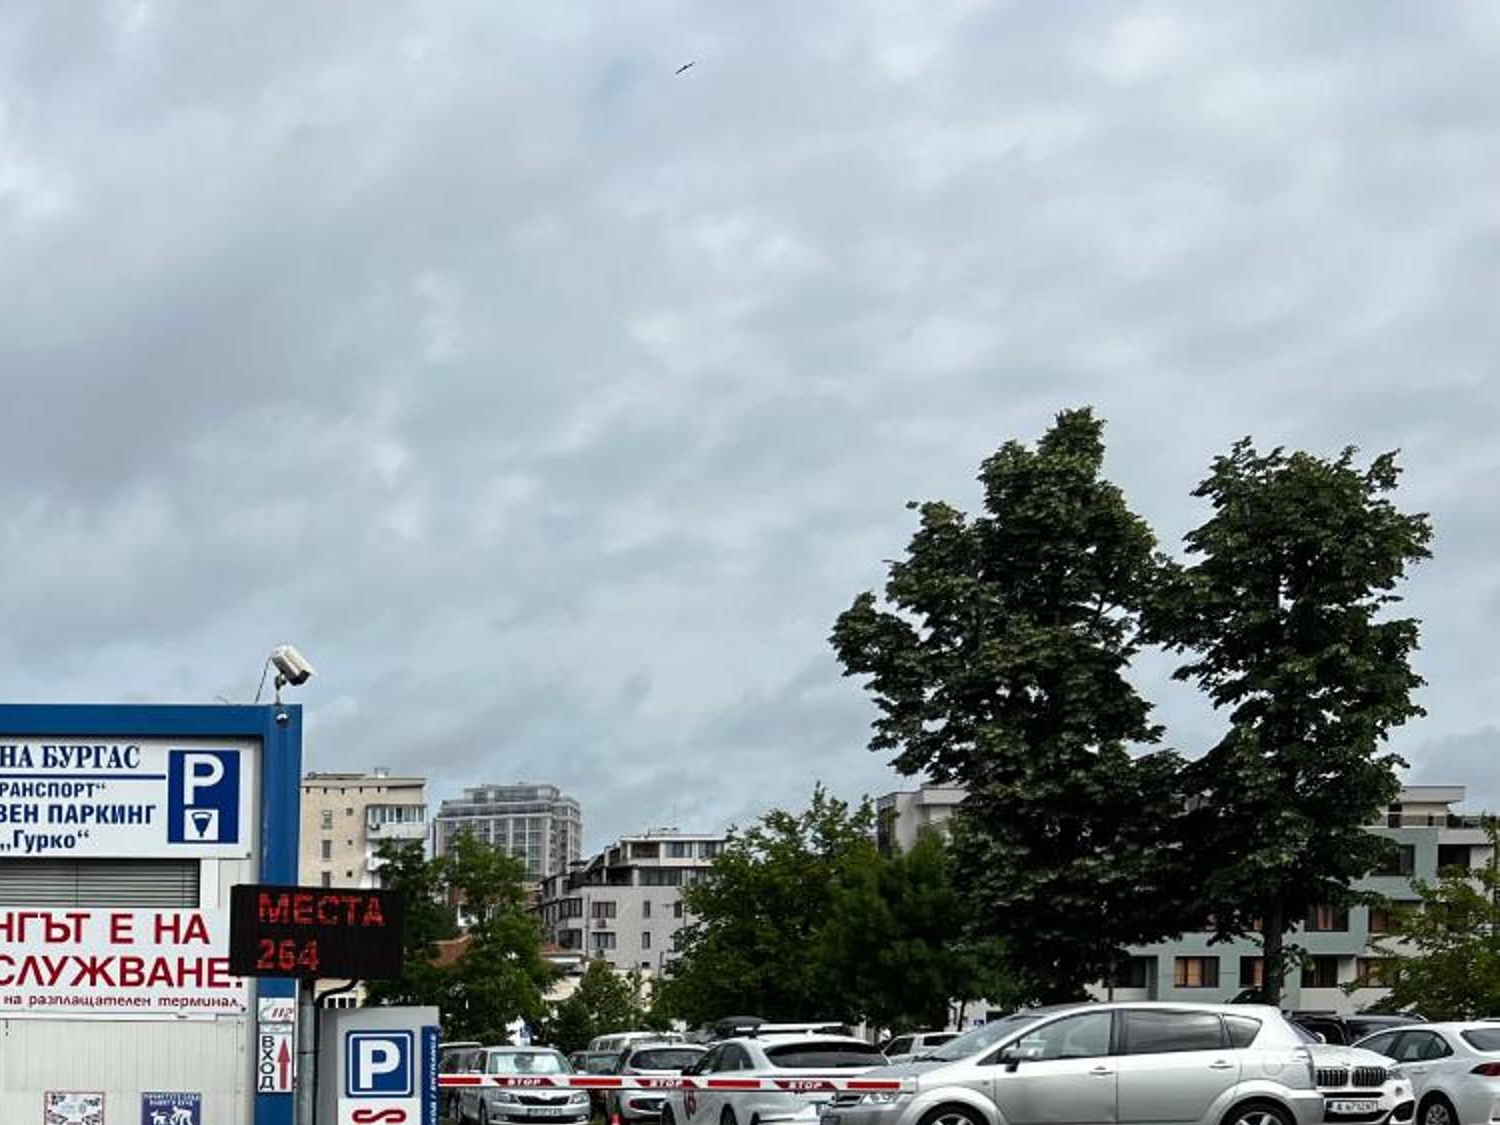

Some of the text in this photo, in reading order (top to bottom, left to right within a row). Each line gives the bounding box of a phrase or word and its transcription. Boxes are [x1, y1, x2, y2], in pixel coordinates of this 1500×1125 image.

[40, 744, 141, 770] БУРГАС
[184, 753, 225, 805] P
[47, 804, 157, 825] ПАРКИНГ
[0, 830, 89, 853] „Гурко“
[258, 892, 386, 926] МЕСТА
[110, 913, 134, 945] Е
[154, 913, 211, 945] НА
[257, 938, 319, 971] 264
[4, 994, 23, 1005] на
[29, 994, 152, 1009] разплащателен
[259, 1035, 275, 1090] ВХОД
[359, 1039, 401, 1089] P
[507, 1077, 542, 1086] STOP
[650, 1079, 684, 1088] STOP
[789, 1081, 823, 1089] STOP
